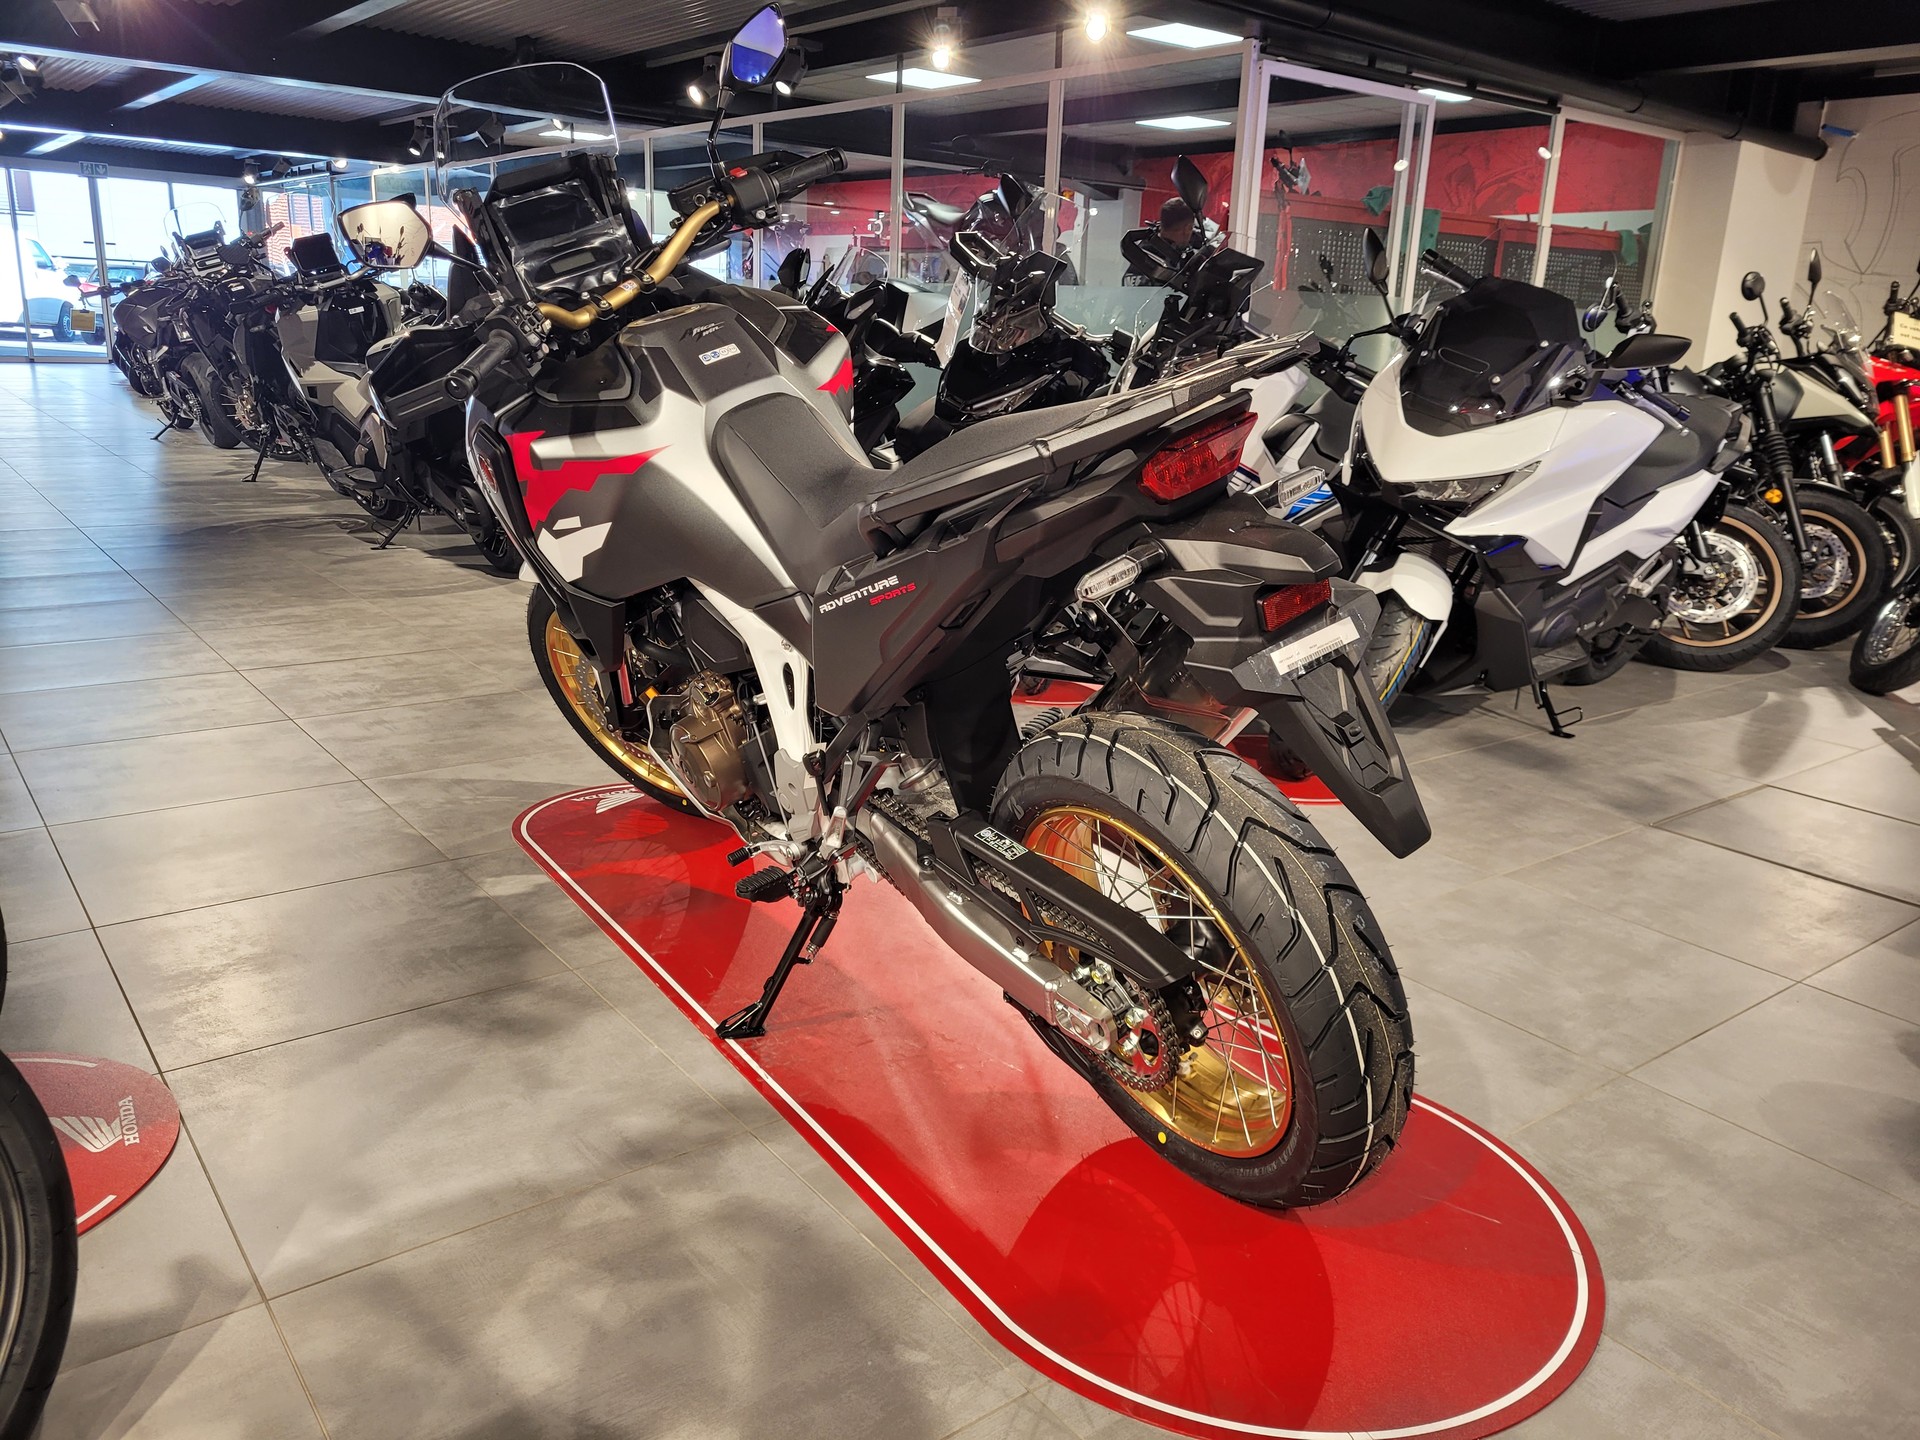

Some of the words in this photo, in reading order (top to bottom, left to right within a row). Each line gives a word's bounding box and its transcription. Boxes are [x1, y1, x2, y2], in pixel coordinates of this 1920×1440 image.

[819, 575, 899, 614] ADVENTURE
[869, 582, 917, 606] SPORTS
[570, 787, 639, 802] HONDA
[118, 1095, 140, 1147] HONDA
